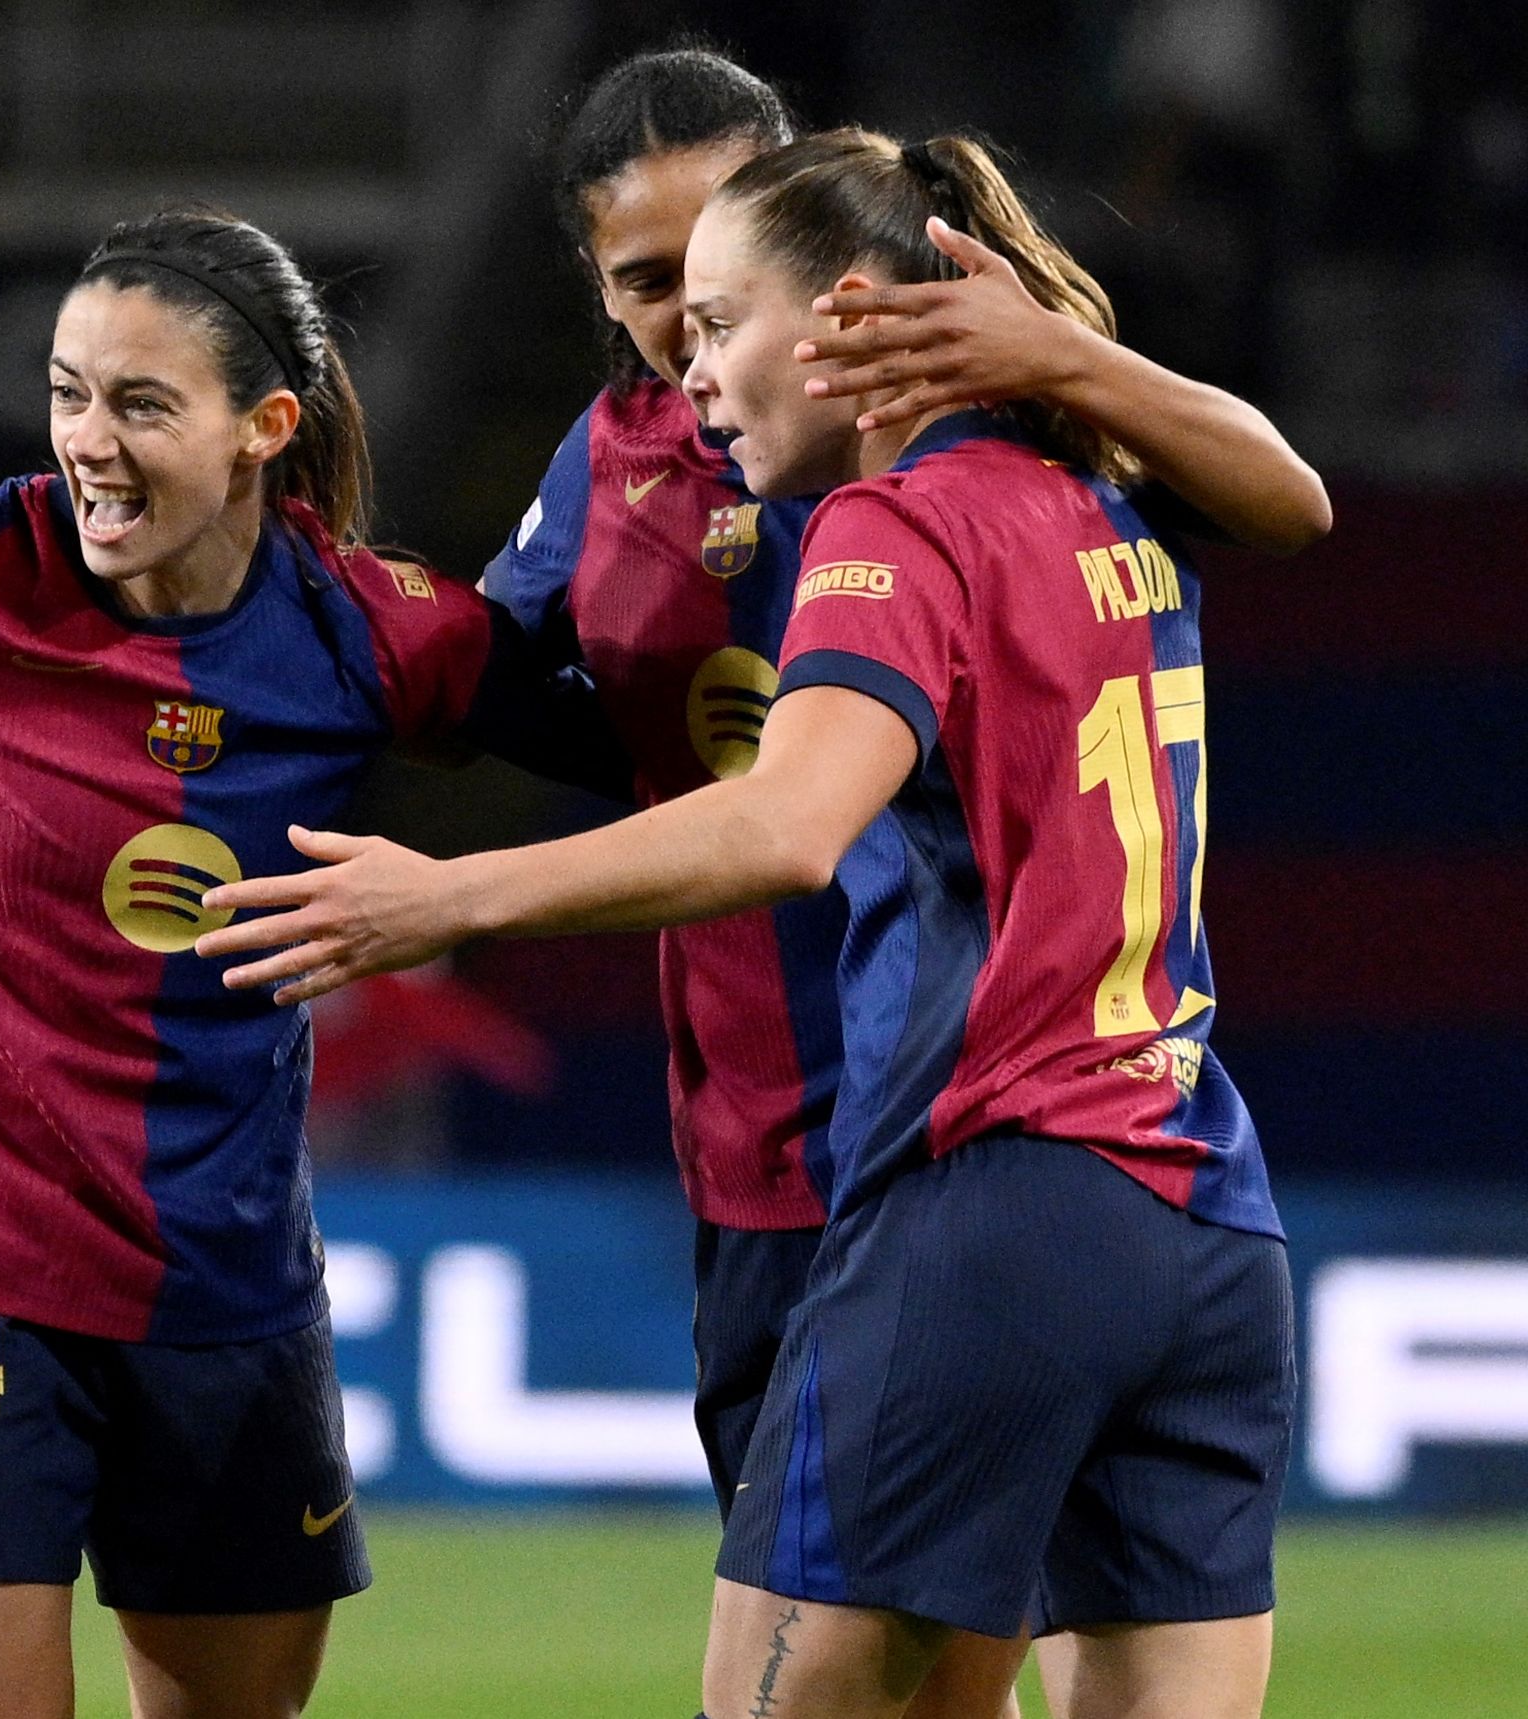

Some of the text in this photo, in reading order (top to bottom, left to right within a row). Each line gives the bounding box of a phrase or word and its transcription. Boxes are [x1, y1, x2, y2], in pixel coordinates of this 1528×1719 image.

[796, 566, 894, 608] BIMBO
[1075, 538, 1182, 623] PAJOR
[1078, 665, 1216, 1037] 17
